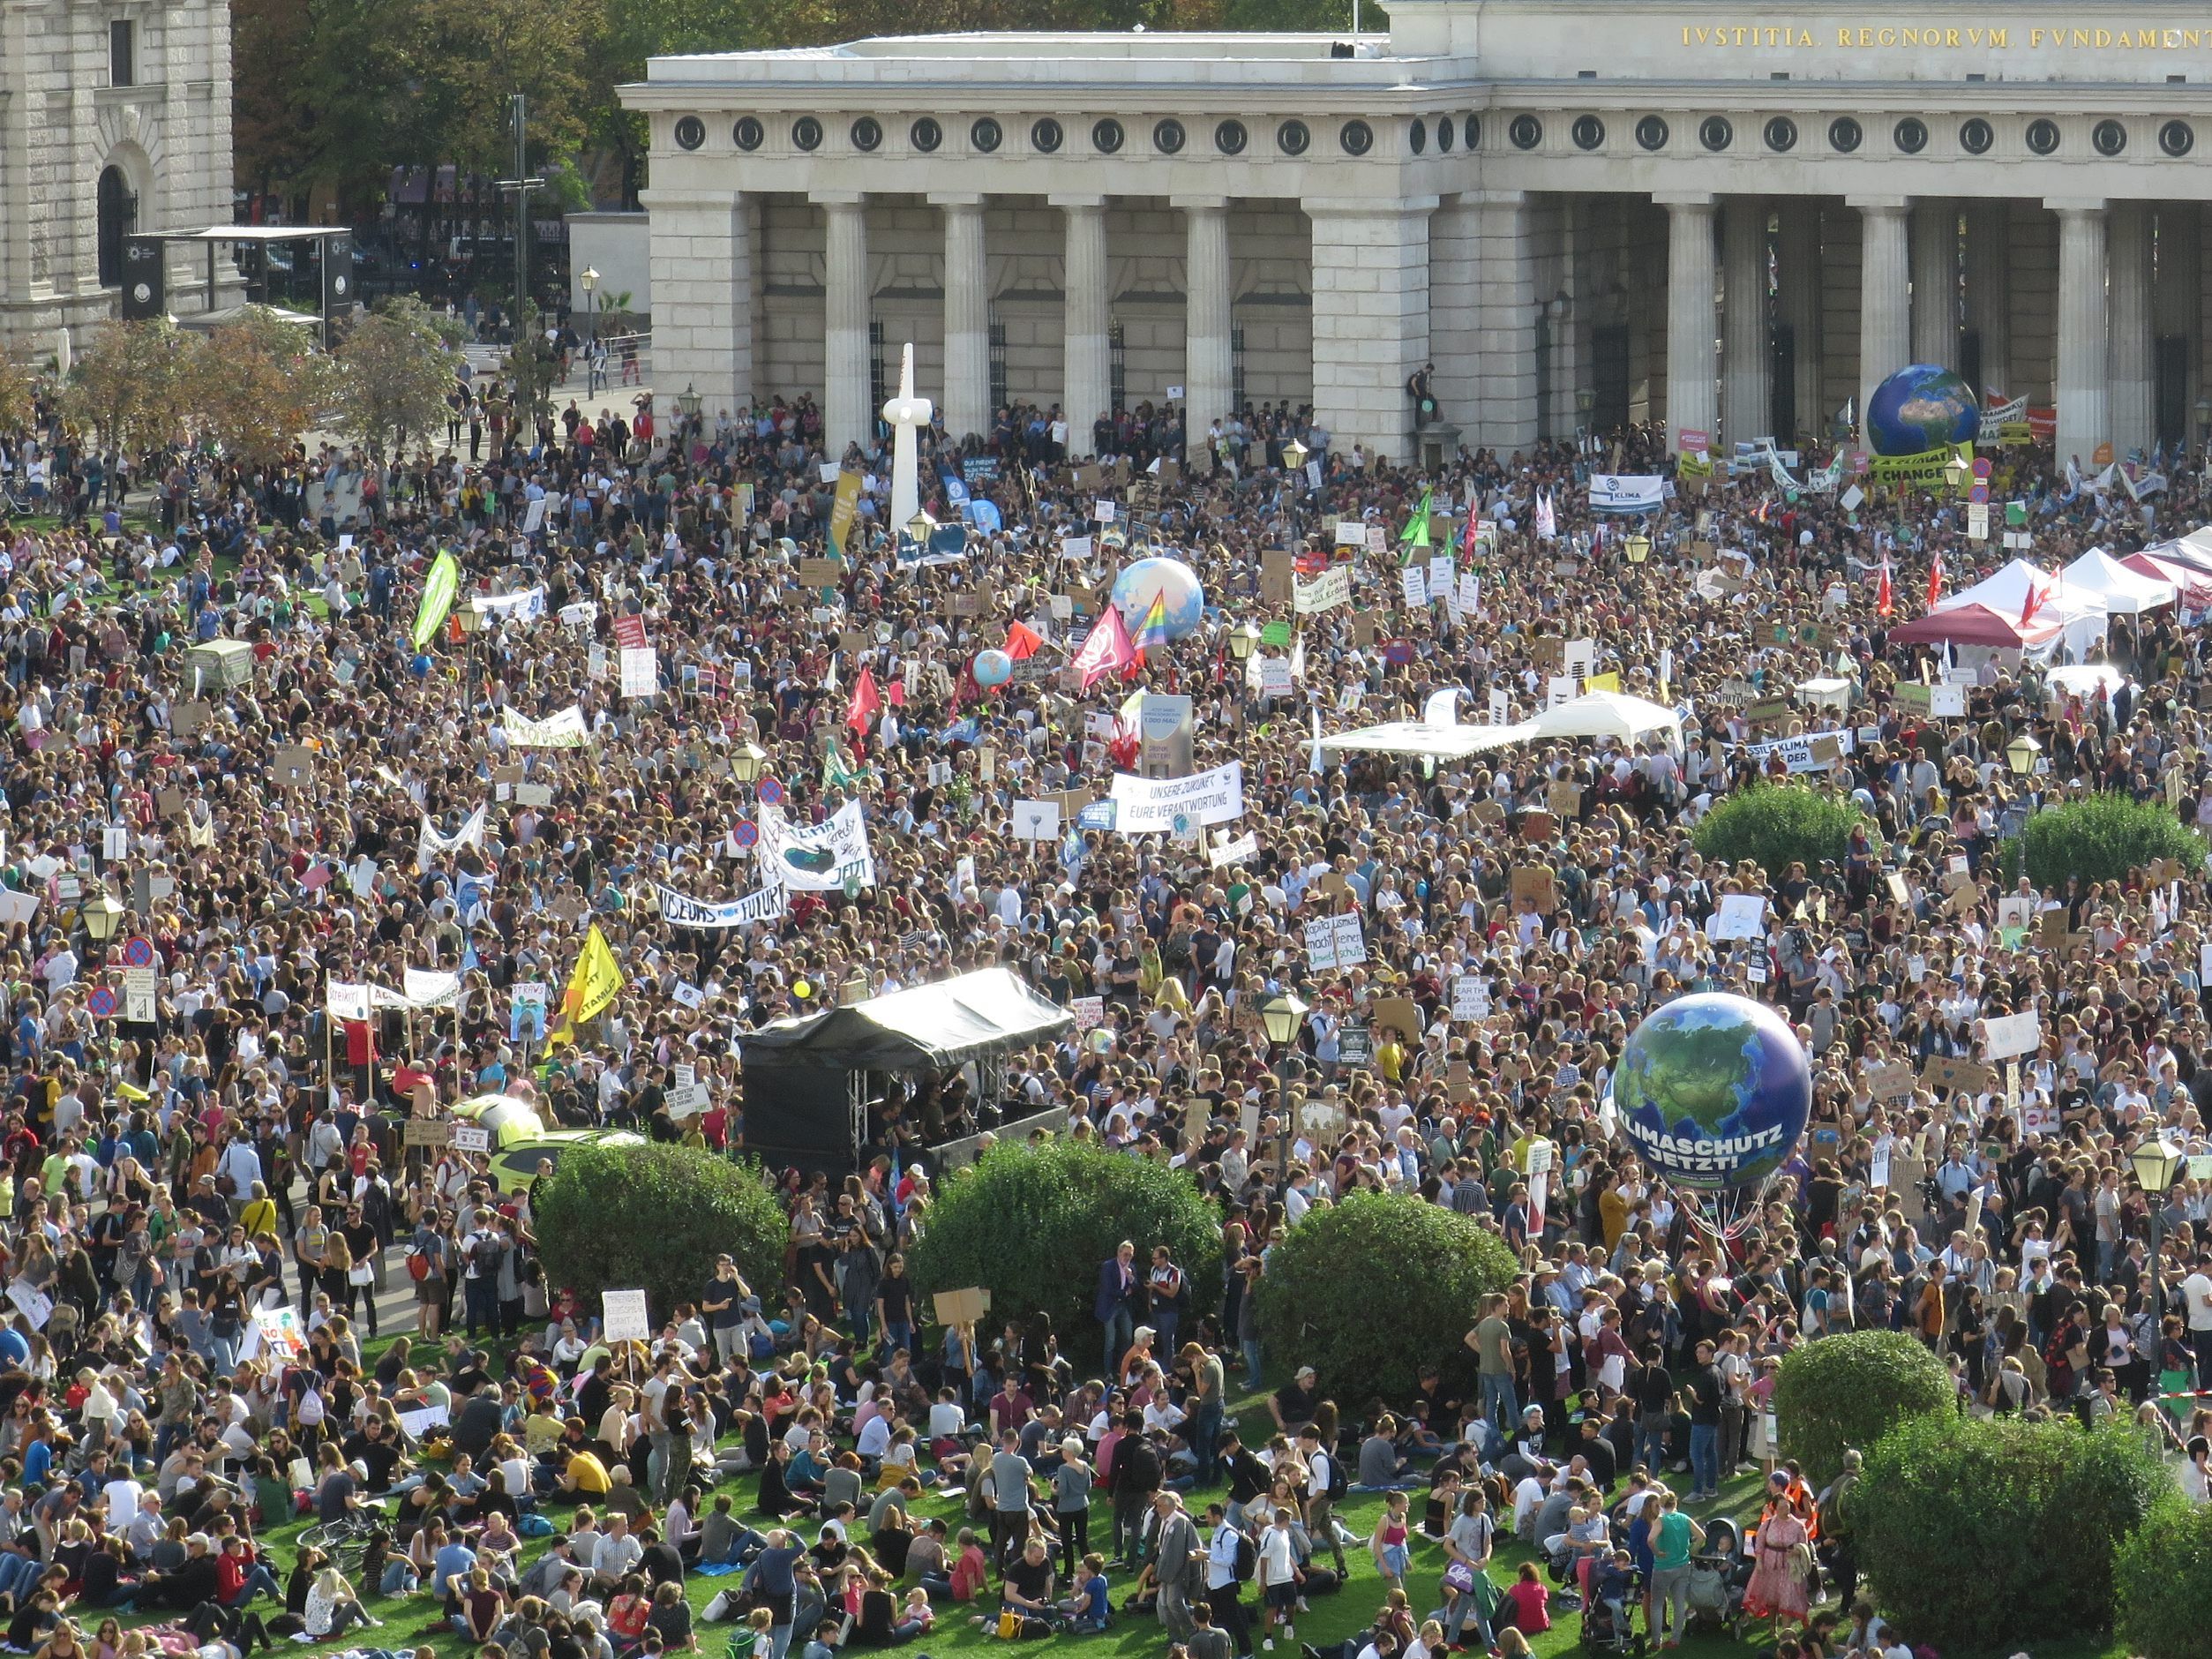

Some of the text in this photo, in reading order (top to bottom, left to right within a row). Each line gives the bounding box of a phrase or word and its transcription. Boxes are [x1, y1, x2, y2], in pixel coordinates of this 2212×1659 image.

[1897, 452, 1946, 465] CLIMAT
[1883, 468, 1944, 481] CHANGE
[1748, 741, 1809, 756] SSILE KLIMA
[1788, 753, 1808, 763] DER
[1150, 774, 1216, 799] UNSERE ZUKUNFT
[1129, 805, 1156, 819] EURE
[1157, 791, 1228, 818] VERANTWORTUNG
[1307, 935, 1333, 950] macht
[1647, 1145, 1738, 1171] JETZT!
